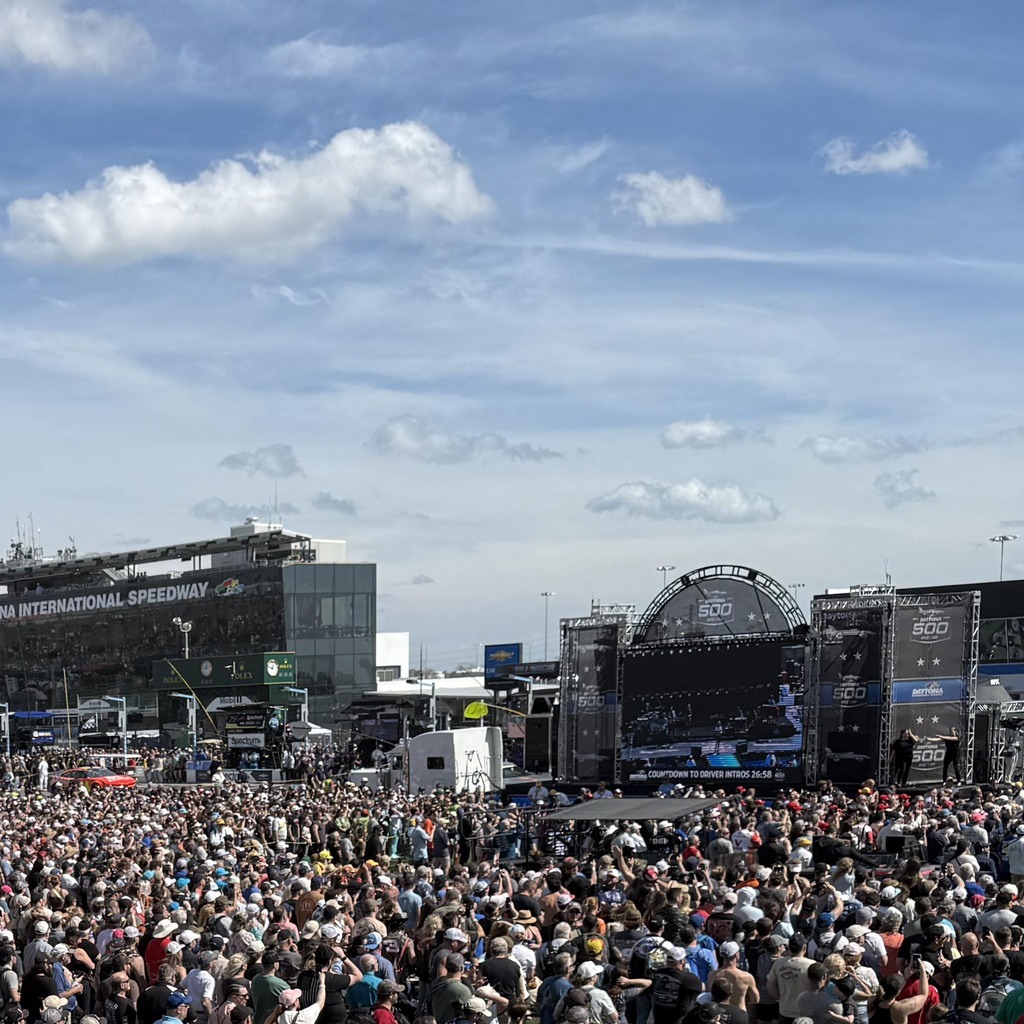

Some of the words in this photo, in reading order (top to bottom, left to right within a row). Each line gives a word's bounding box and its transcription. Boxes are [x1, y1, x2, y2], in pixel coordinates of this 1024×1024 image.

[18, 592, 124, 617] INTERNATIONAL
[127, 582, 209, 606] SPEEDWAY
[698, 603, 732, 617] 500
[912, 622, 949, 635] 500
[833, 687, 866, 700] 500
[912, 687, 943, 696] DAYTONA
[578, 695, 605, 707] 500
[230, 736, 262, 745] Spectrum
[912, 749, 945, 762] 500
[648, 770, 688, 779] COUNTDOWN
[690, 770, 698, 779] TO
[700, 770, 724, 779] DRIVER
[725, 770, 750, 779] INTROS
[751, 770, 772, 779] 26:58
